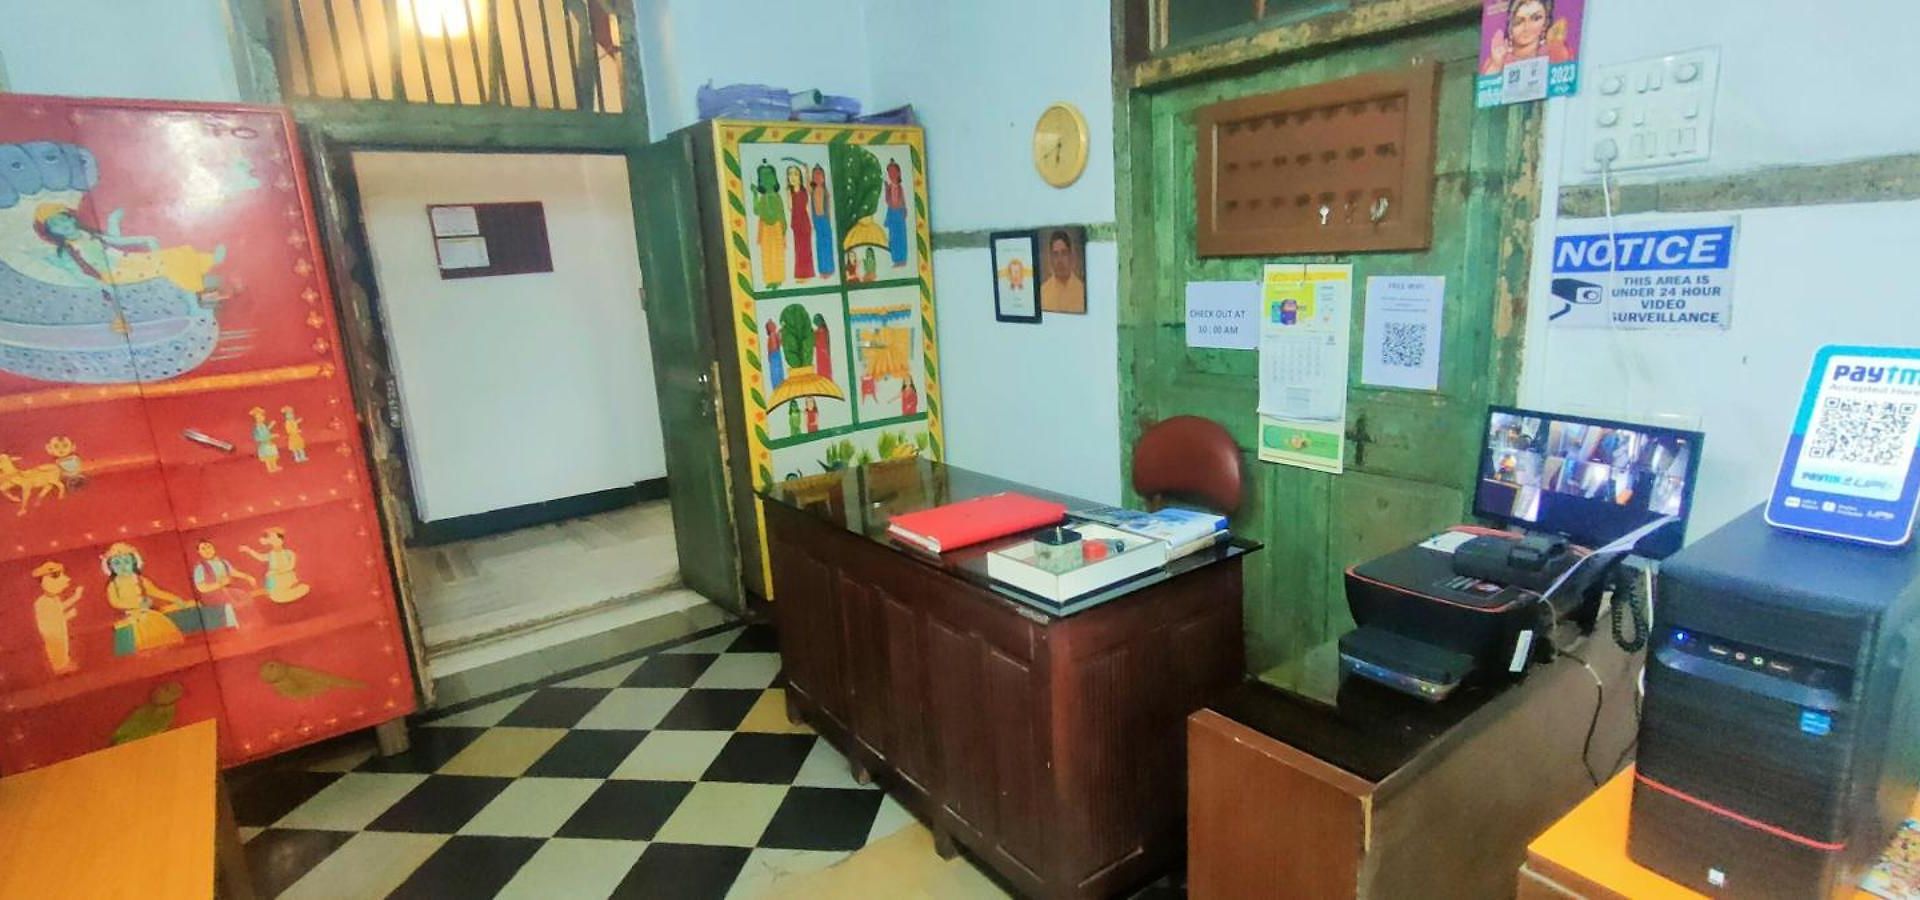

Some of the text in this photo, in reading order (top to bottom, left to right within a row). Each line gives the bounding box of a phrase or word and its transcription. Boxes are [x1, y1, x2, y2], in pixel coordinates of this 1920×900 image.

[1550, 63, 1576, 84] 2023
[1555, 233, 1723, 269] NOTICE
[1624, 275, 1710, 286] THIS AREA IS
[1611, 286, 1721, 297] UNDER 24 HOUR
[1641, 299, 1687, 310] VIDEO
[1189, 309, 1246, 318] CHECK OUT AT
[1223, 325, 1238, 335] AM
[1829, 384, 1888, 394] Accepted
